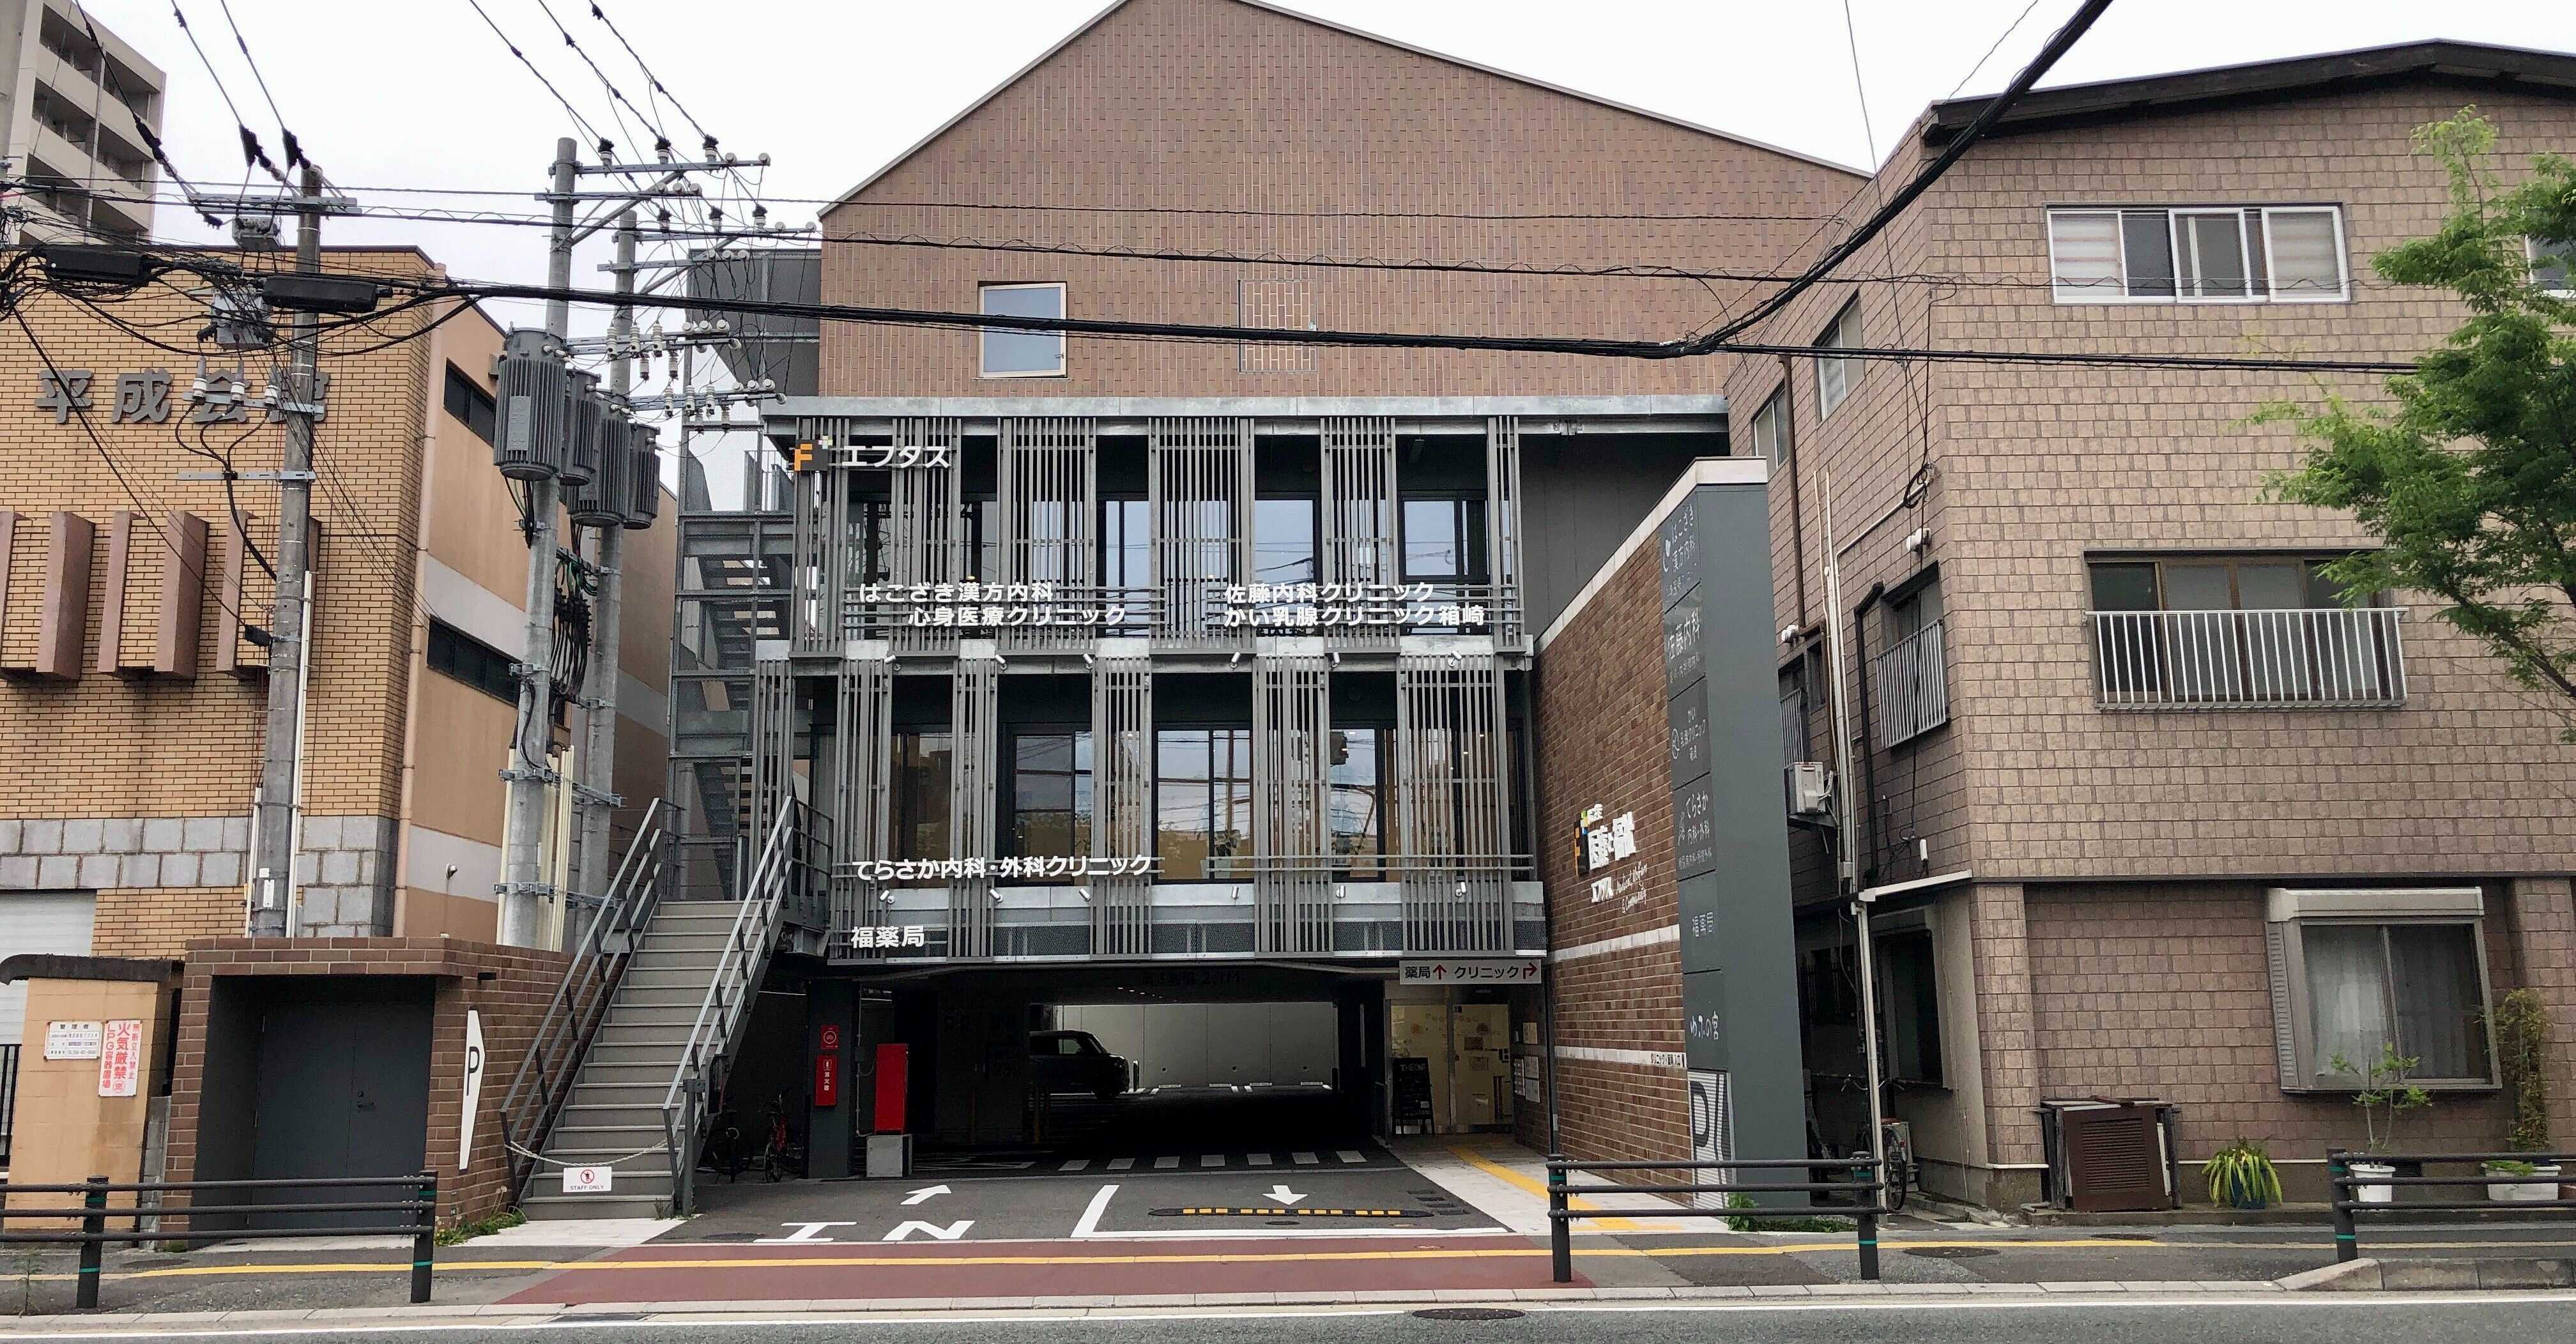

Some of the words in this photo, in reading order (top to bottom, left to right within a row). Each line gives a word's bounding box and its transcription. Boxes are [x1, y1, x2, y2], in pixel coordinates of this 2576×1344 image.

[841, 445, 950, 469] エフタス
[859, 582, 1054, 603] はこざき漢方内科
[1225, 582, 1434, 604] 佐藤内科クリニック
[908, 606, 1126, 627] 心身医療クリニック
[1223, 604, 1485, 627] かい乳腺クリニック箱崎
[1667, 606, 1700, 660] 佐藤内科
[852, 855, 1151, 881] てらさか内科・外科クリニック
[850, 926, 925, 949] 福薬局
[1405, 966, 1430, 979] 薬局
[1453, 966, 1519, 979] クリニック
[114, 1022, 130, 1080] 火気厳禁
[466, 1046, 480, 1096] P
[753, 1220, 976, 1243] IN
